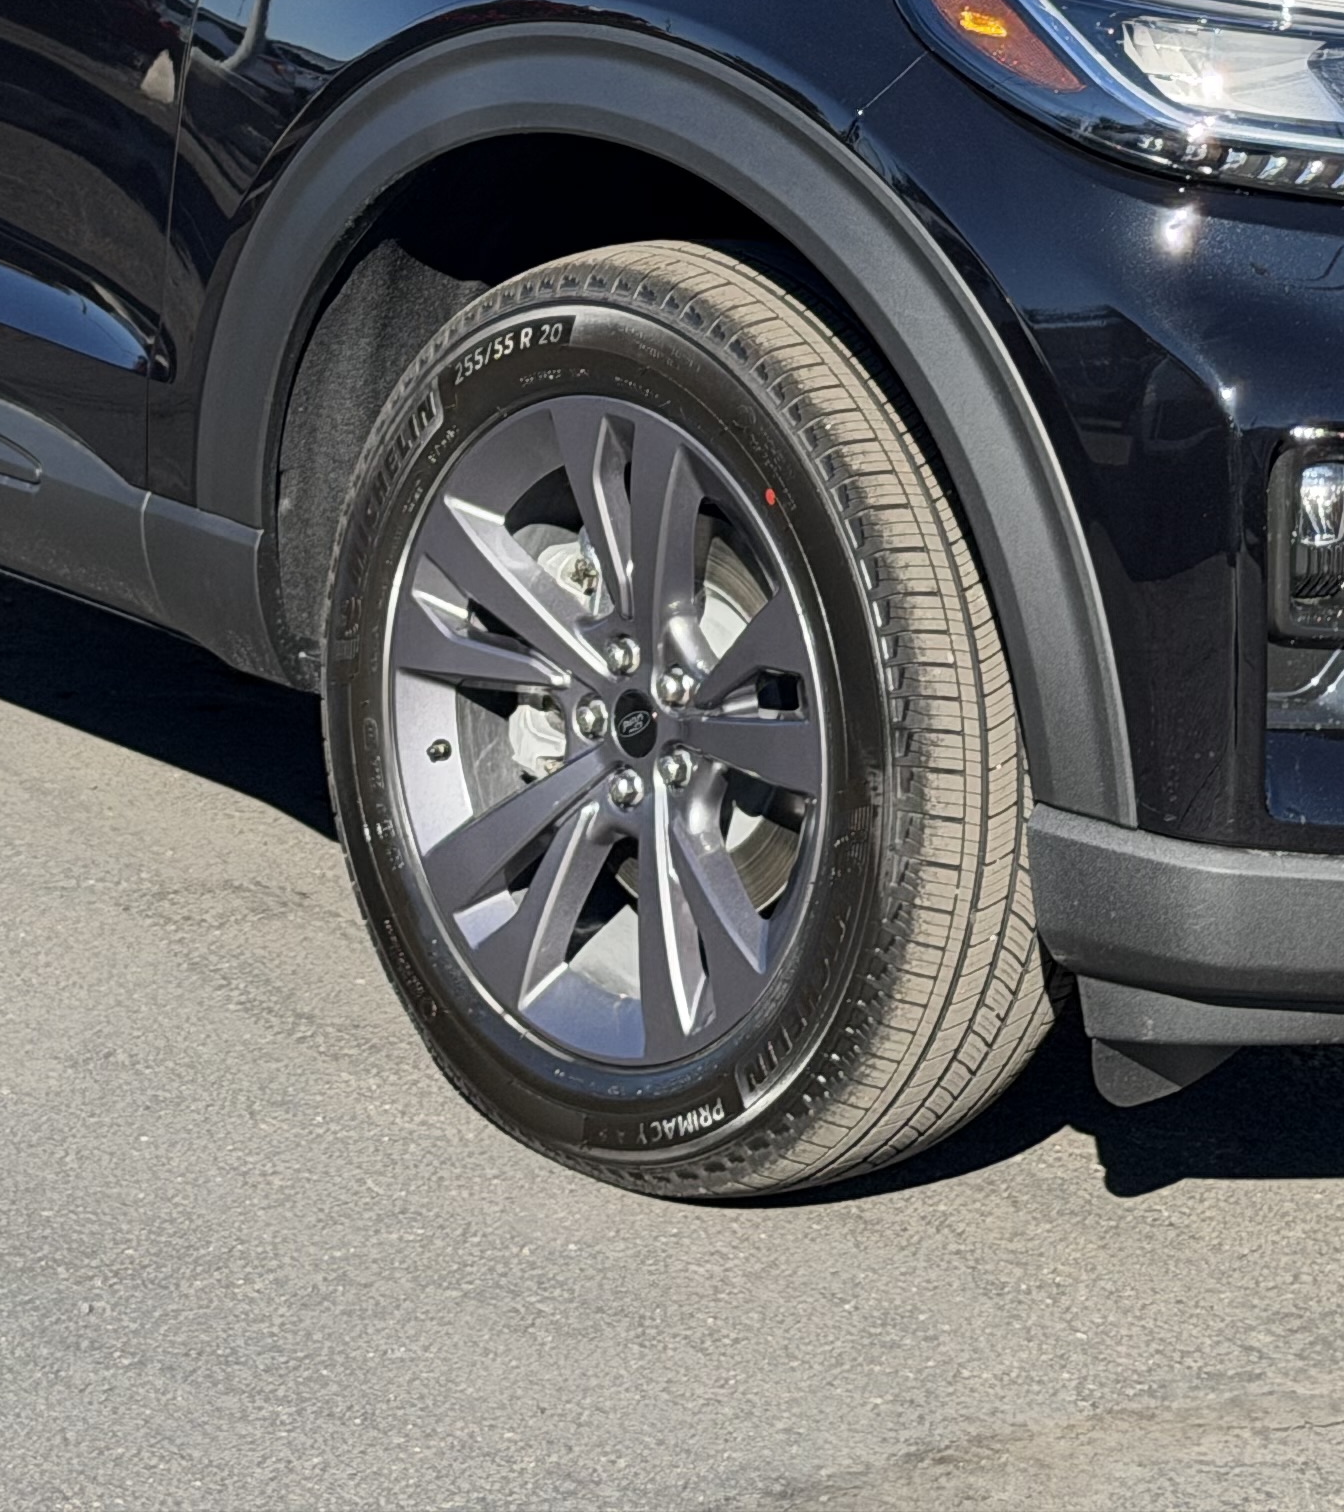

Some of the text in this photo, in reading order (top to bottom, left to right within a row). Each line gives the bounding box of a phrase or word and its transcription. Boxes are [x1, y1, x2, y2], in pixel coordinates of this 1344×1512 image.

[455, 332, 515, 385] 255/55
[520, 327, 533, 350] R
[538, 323, 562, 345] 20
[636, 1097, 725, 1144] PRIMACY
